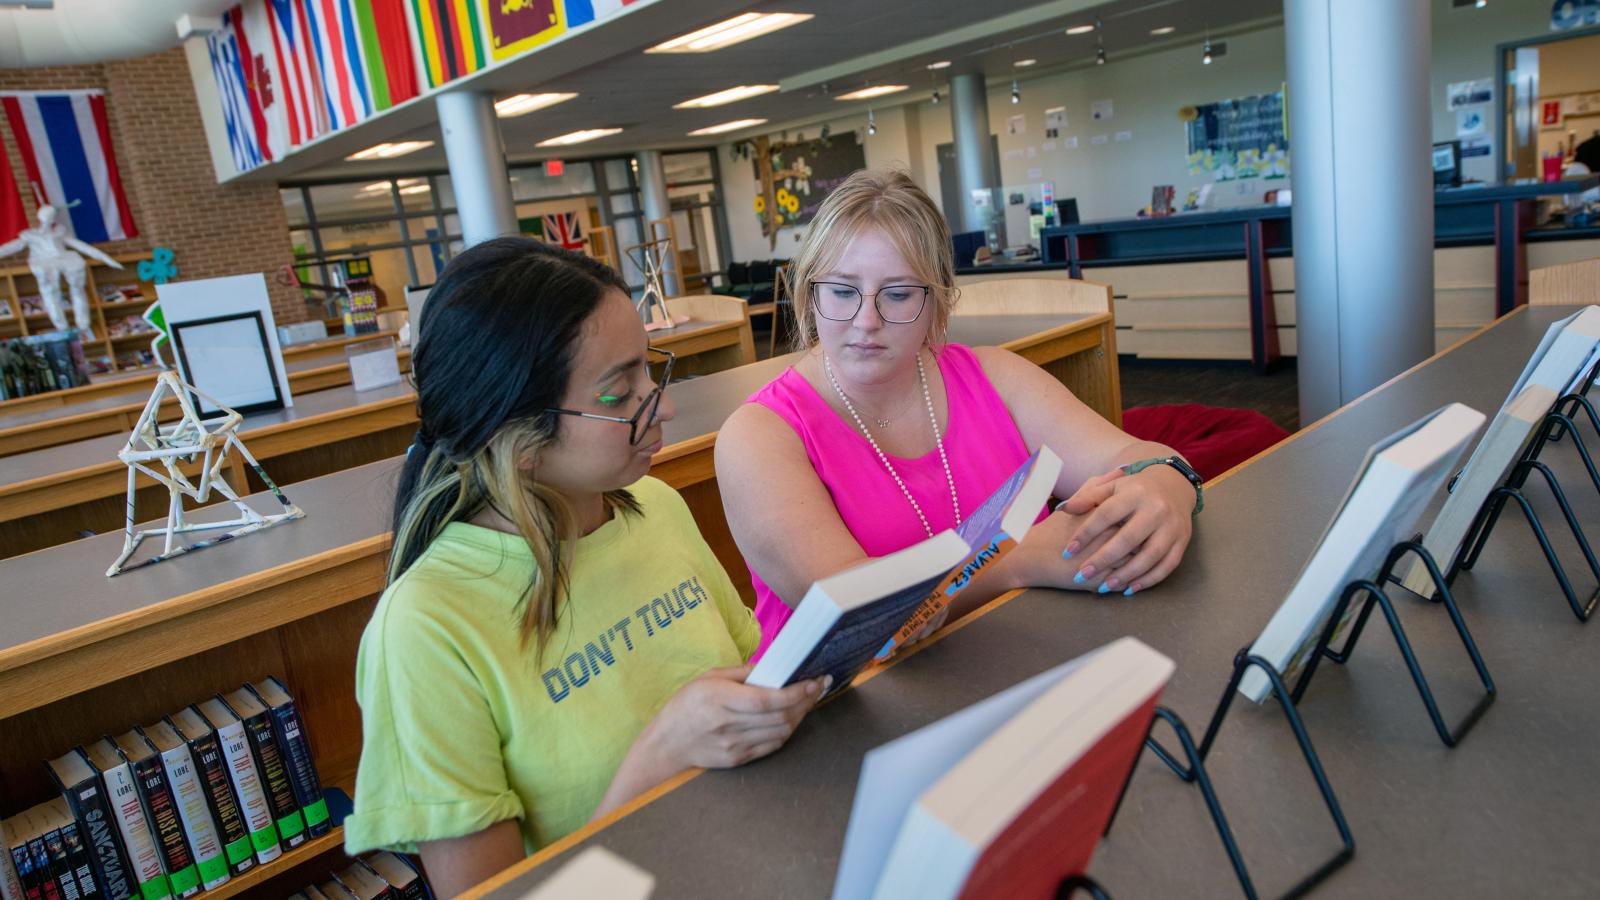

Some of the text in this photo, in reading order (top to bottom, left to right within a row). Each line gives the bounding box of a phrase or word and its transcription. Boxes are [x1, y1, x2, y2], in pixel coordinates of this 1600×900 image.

[951, 543, 1000, 588] ALVAREZ
[924, 608, 935, 618] THE
[902, 629, 910, 637] OF
[910, 618, 924, 630] TIME
[541, 576, 708, 703] DON'T TOUCH
[229, 742, 244, 753] LORE
[202, 751, 217, 764] LORE
[233, 753, 251, 774] THE
[174, 765, 189, 778] LORE
[206, 765, 225, 784] THE
[260, 743, 296, 814] UNITED AS ONE
[117, 784, 133, 797] LORE
[146, 775, 162, 789] LORE
[178, 779, 197, 799] THE
[121, 798, 141, 820] THE
[149, 790, 170, 812] THE
[211, 782, 238, 824] REVENGE
[247, 799, 264, 810] OF
[155, 809, 178, 835] RISE
[224, 821, 242, 834] OF
[251, 810, 269, 831] TEN
[163, 831, 182, 847] OF
[86, 808, 130, 900] SANCTUARY
